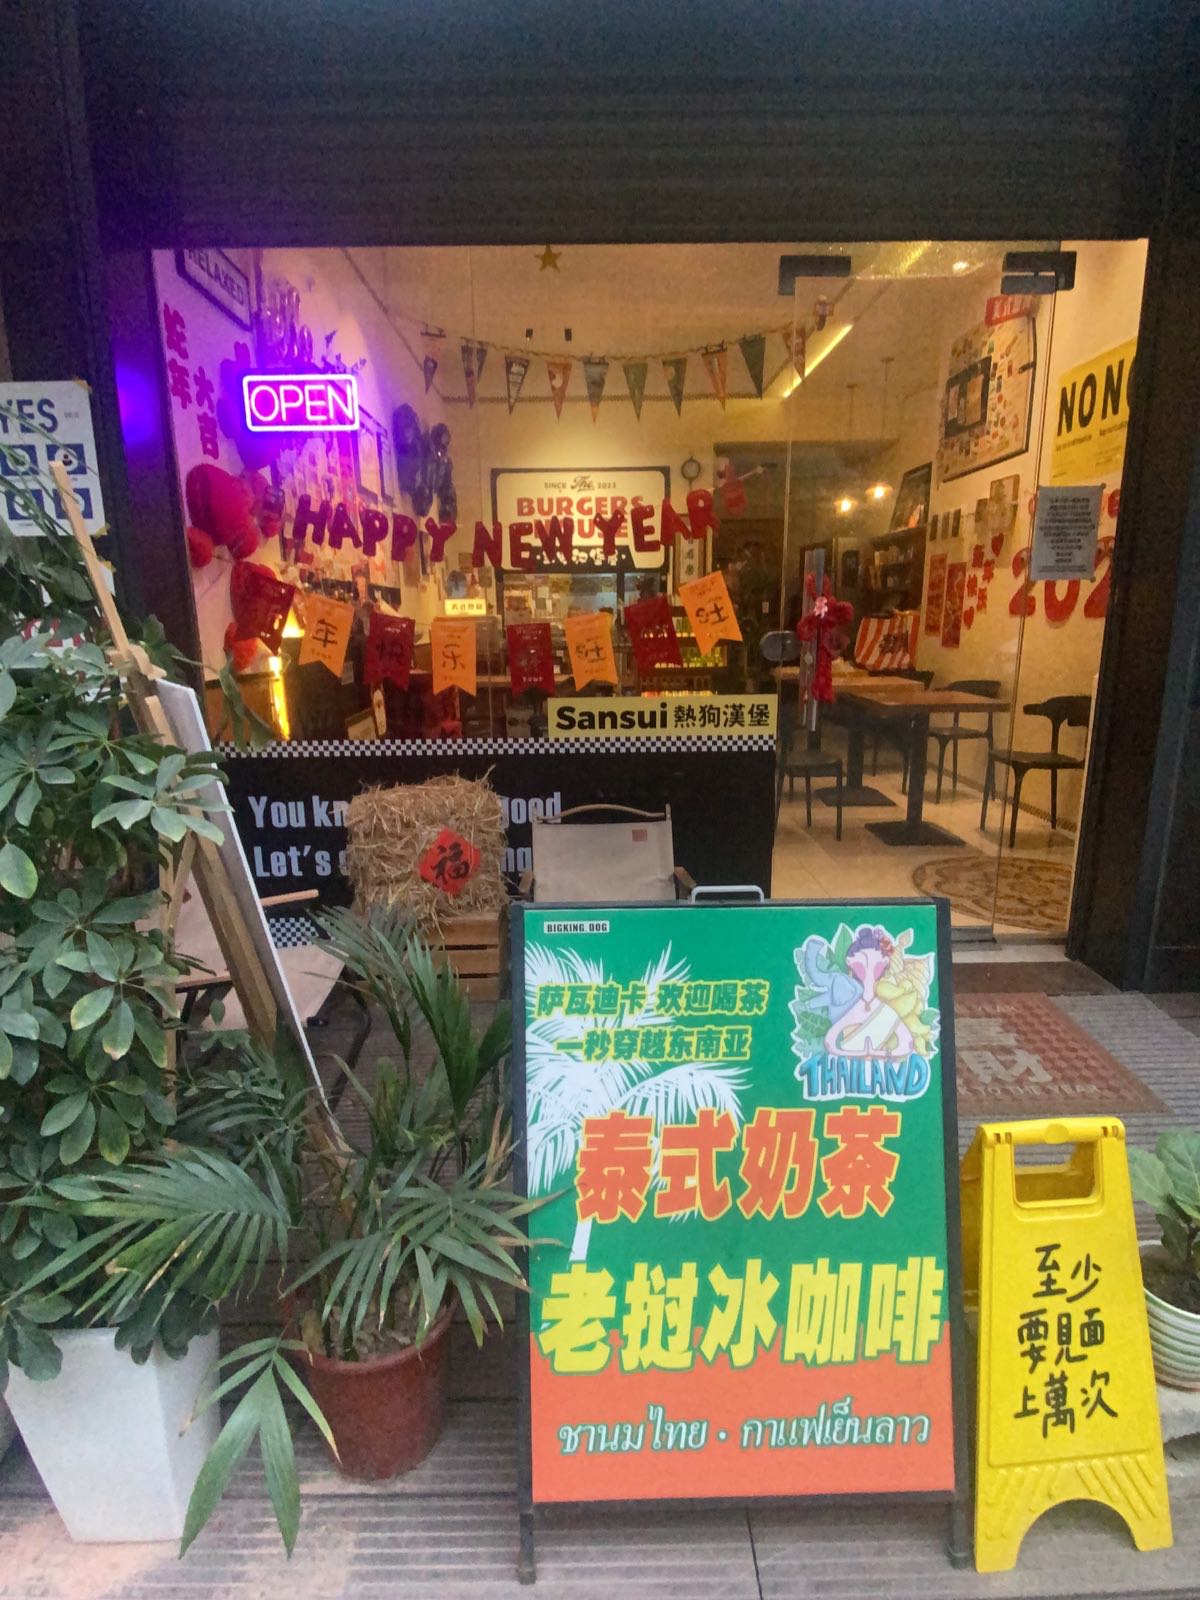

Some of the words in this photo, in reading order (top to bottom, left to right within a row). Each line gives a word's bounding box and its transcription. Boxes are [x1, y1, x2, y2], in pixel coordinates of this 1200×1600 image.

[250, 384, 354, 422] OPEN
[293, 494, 457, 562] HAPPY
[472, 512, 574, 570] NEW
[593, 488, 720, 552] YEAR
[312, 619, 338, 648] 年
[556, 702, 667, 730] Sansui
[673, 703, 770, 729] 熱狗漢堡
[248, 796, 306, 828] You
[254, 845, 331, 877] Let's
[431, 842, 470, 885] 福
[536, 982, 648, 1016] 萨瓦迪卡
[654, 979, 769, 1016] 欢迎喝茶
[555, 1026, 753, 1062] 一秒穿越东南亚
[800, 1051, 931, 1101] THAILAND
[576, 1105, 902, 1223] 泰式奶茶
[1033, 1243, 1102, 1303] 至少
[537, 1256, 945, 1374] 老挝冰咖啡
[1017, 1308, 1105, 1373] 要見面
[1013, 1369, 1118, 1439] 上萬次
